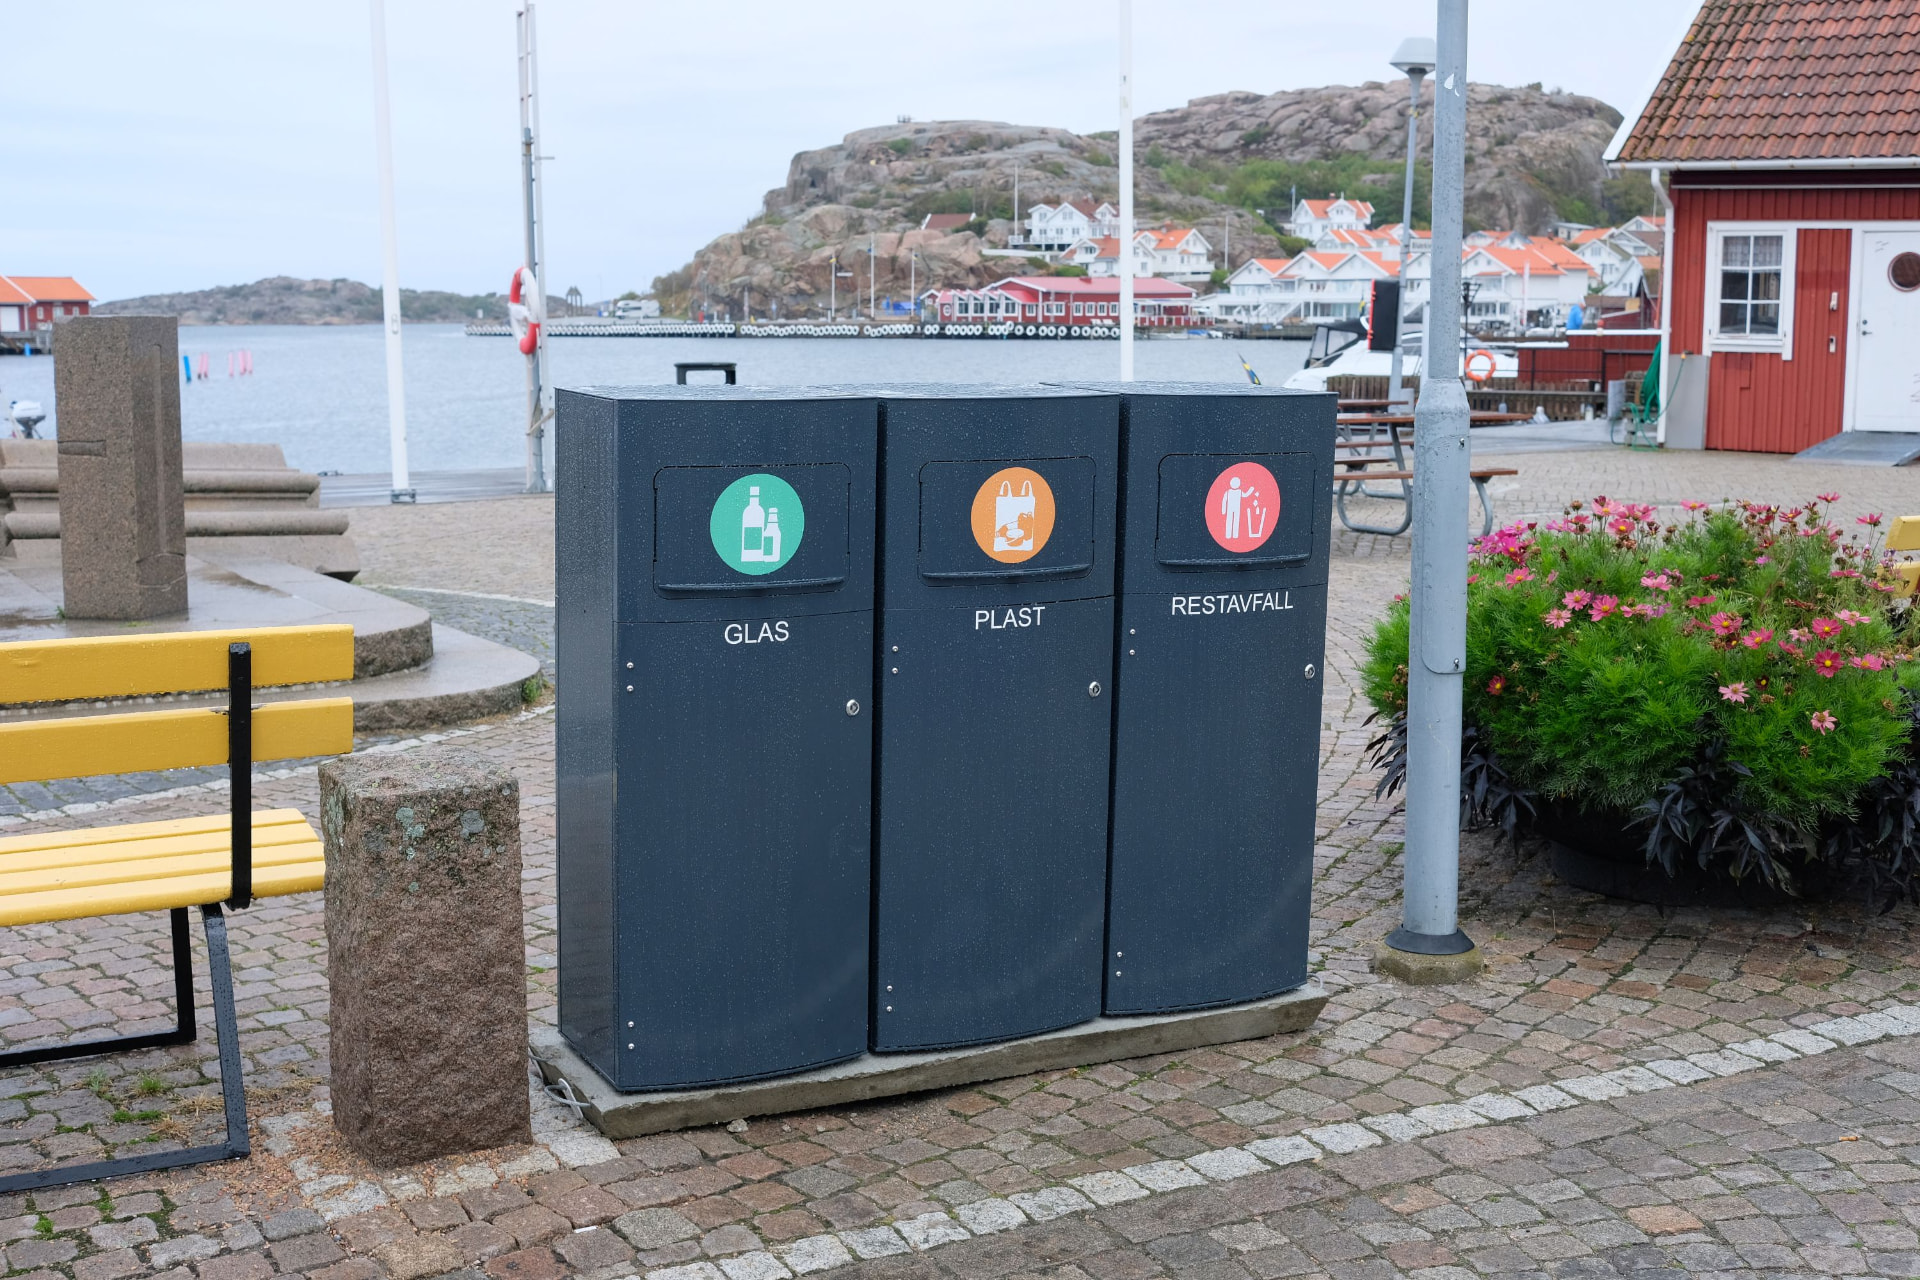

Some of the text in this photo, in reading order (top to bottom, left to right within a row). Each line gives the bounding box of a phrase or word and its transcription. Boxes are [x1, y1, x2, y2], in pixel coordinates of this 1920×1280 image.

[1171, 590, 1294, 616] RESTAVFALL
[975, 606, 1046, 630] PLAST
[724, 620, 789, 645] GLAS
